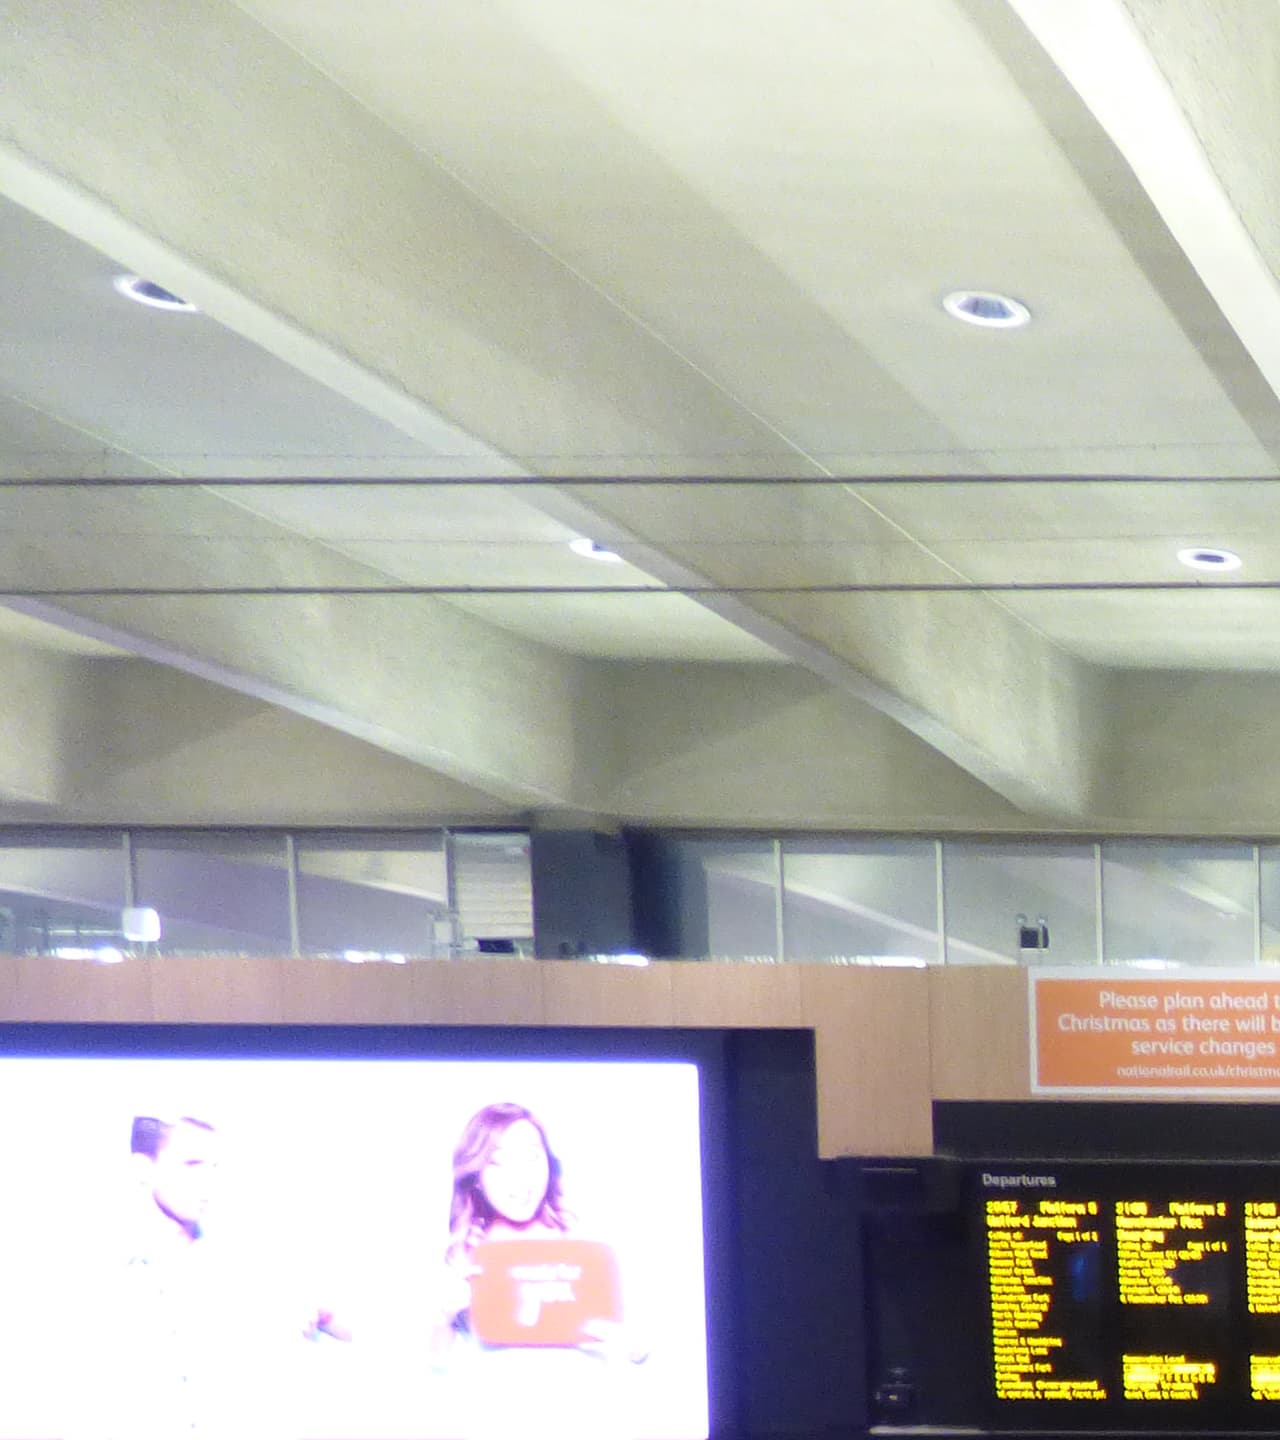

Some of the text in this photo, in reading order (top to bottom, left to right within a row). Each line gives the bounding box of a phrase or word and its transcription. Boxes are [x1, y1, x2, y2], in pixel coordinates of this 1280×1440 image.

[1099, 991, 1158, 1009] Please
[1164, 992, 1204, 1013] plan
[1210, 992, 1268, 1010] ahead
[1058, 1013, 1150, 1032] Christmas
[1156, 1018, 1176, 1032] as
[1182, 1014, 1230, 1032] there
[1236, 1015, 1266, 1032] will
[1131, 1037, 1277, 1060] service changes
[982, 1172, 1056, 1188] Departures
